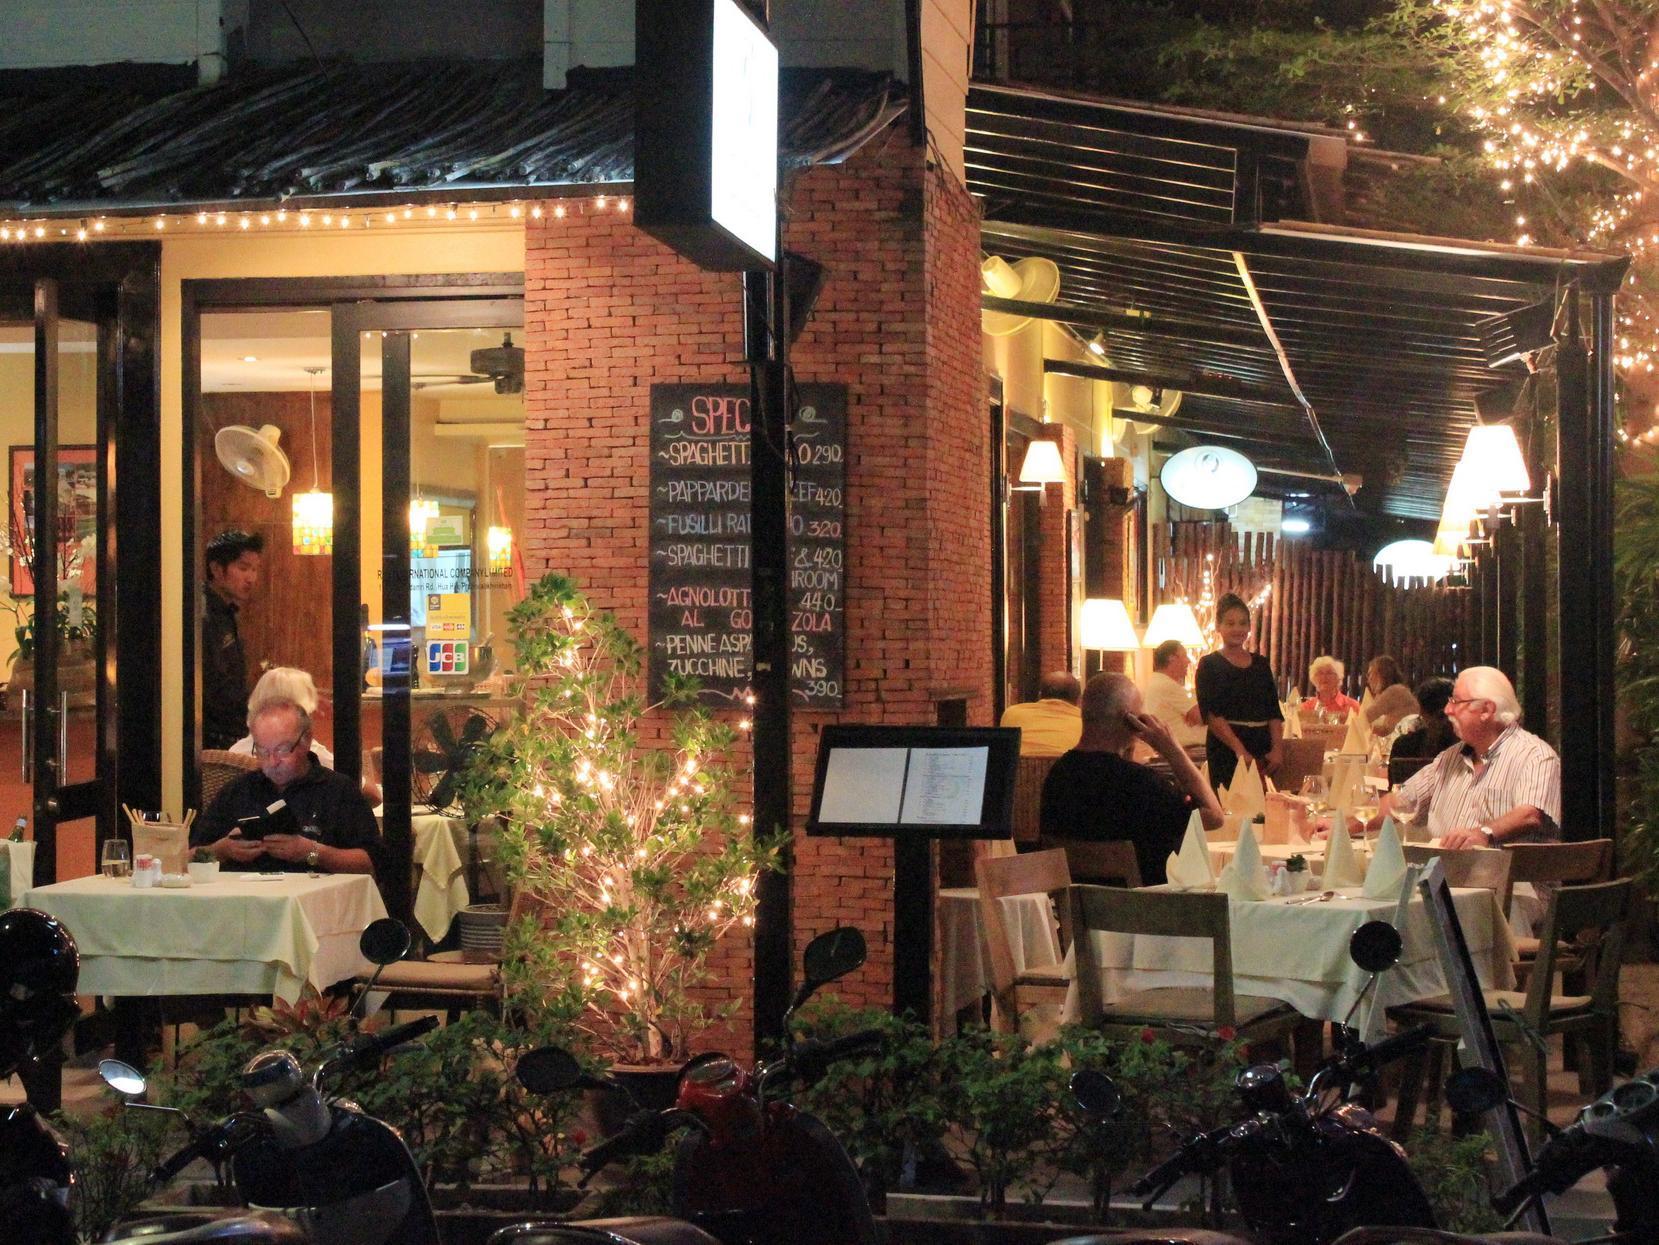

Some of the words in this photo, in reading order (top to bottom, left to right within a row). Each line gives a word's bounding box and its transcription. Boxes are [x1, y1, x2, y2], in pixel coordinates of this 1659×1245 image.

[692, 396, 751, 434] SPEC
[669, 441, 751, 466] SPAGHETT
[668, 514, 722, 535] FUSILLI
[668, 544, 749, 568] SPAGHETTI
[795, 548, 812, 567] &
[791, 570, 838, 590] ROOM
[667, 587, 752, 606] AGNOLOTT
[681, 609, 704, 627] AL
[730, 610, 752, 629] GO
[791, 611, 832, 631] ZOLA
[666, 634, 716, 654] PENNE
